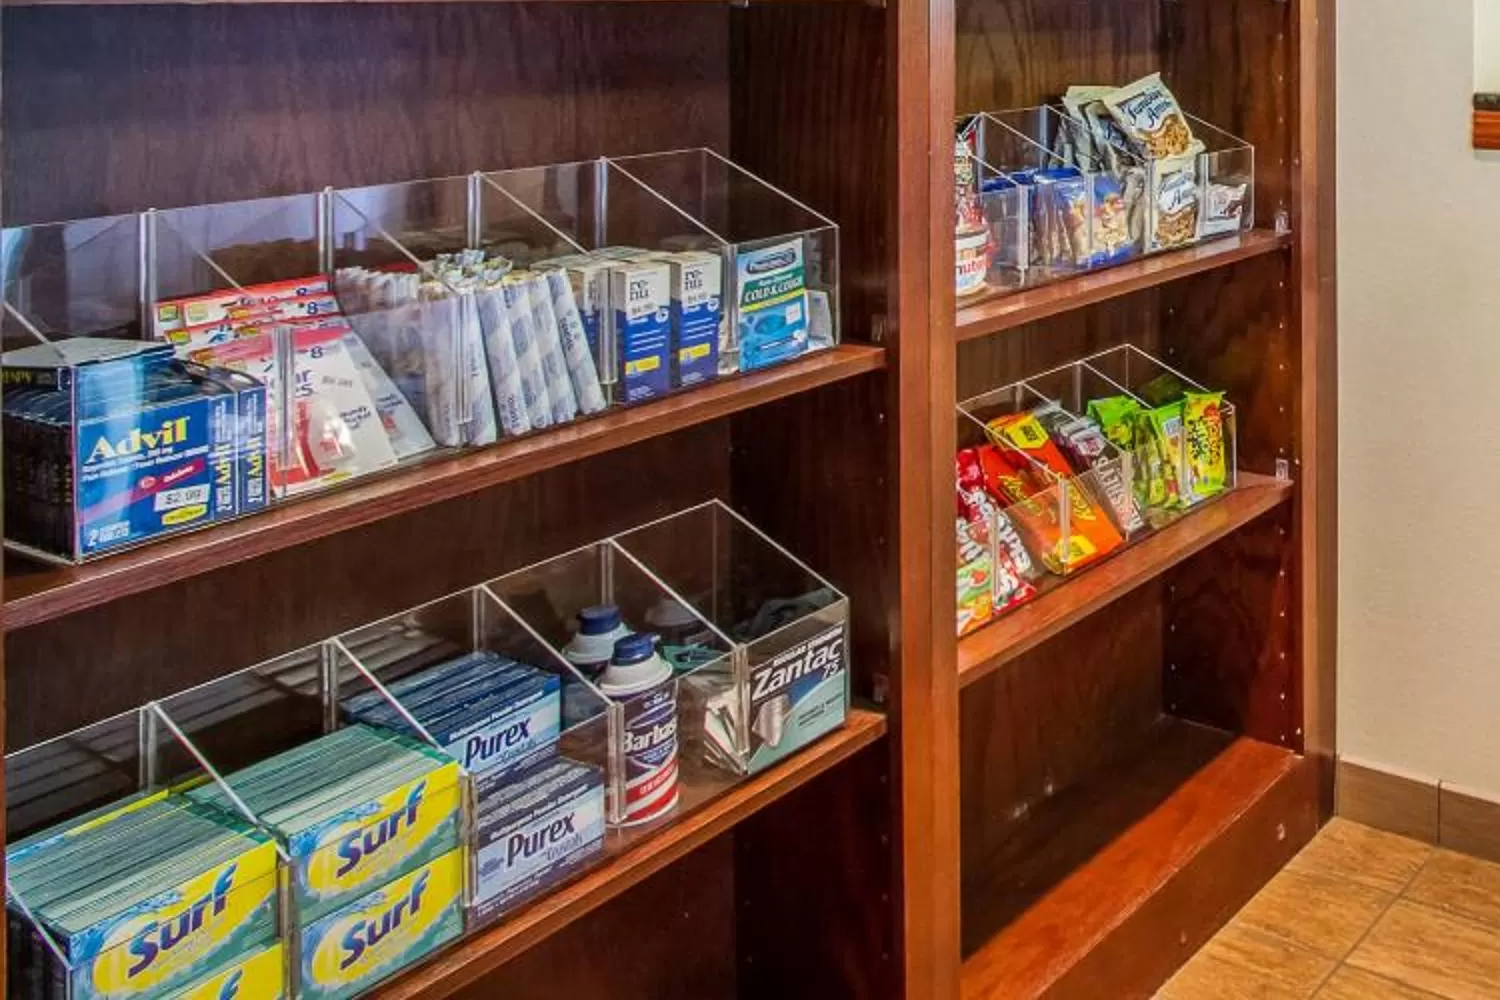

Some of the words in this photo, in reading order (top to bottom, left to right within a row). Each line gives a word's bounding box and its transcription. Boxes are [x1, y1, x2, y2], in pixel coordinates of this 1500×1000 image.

[310, 346, 324, 359] 8
[85, 415, 190, 466] Advil
[752, 637, 843, 701] Zantac
[823, 658, 841, 681] 75
[463, 717, 531, 769] Purex
[336, 780, 427, 879] Surf
[507, 811, 576, 868] Purex
[127, 863, 238, 979] Surf
[340, 869, 431, 971] Surf
